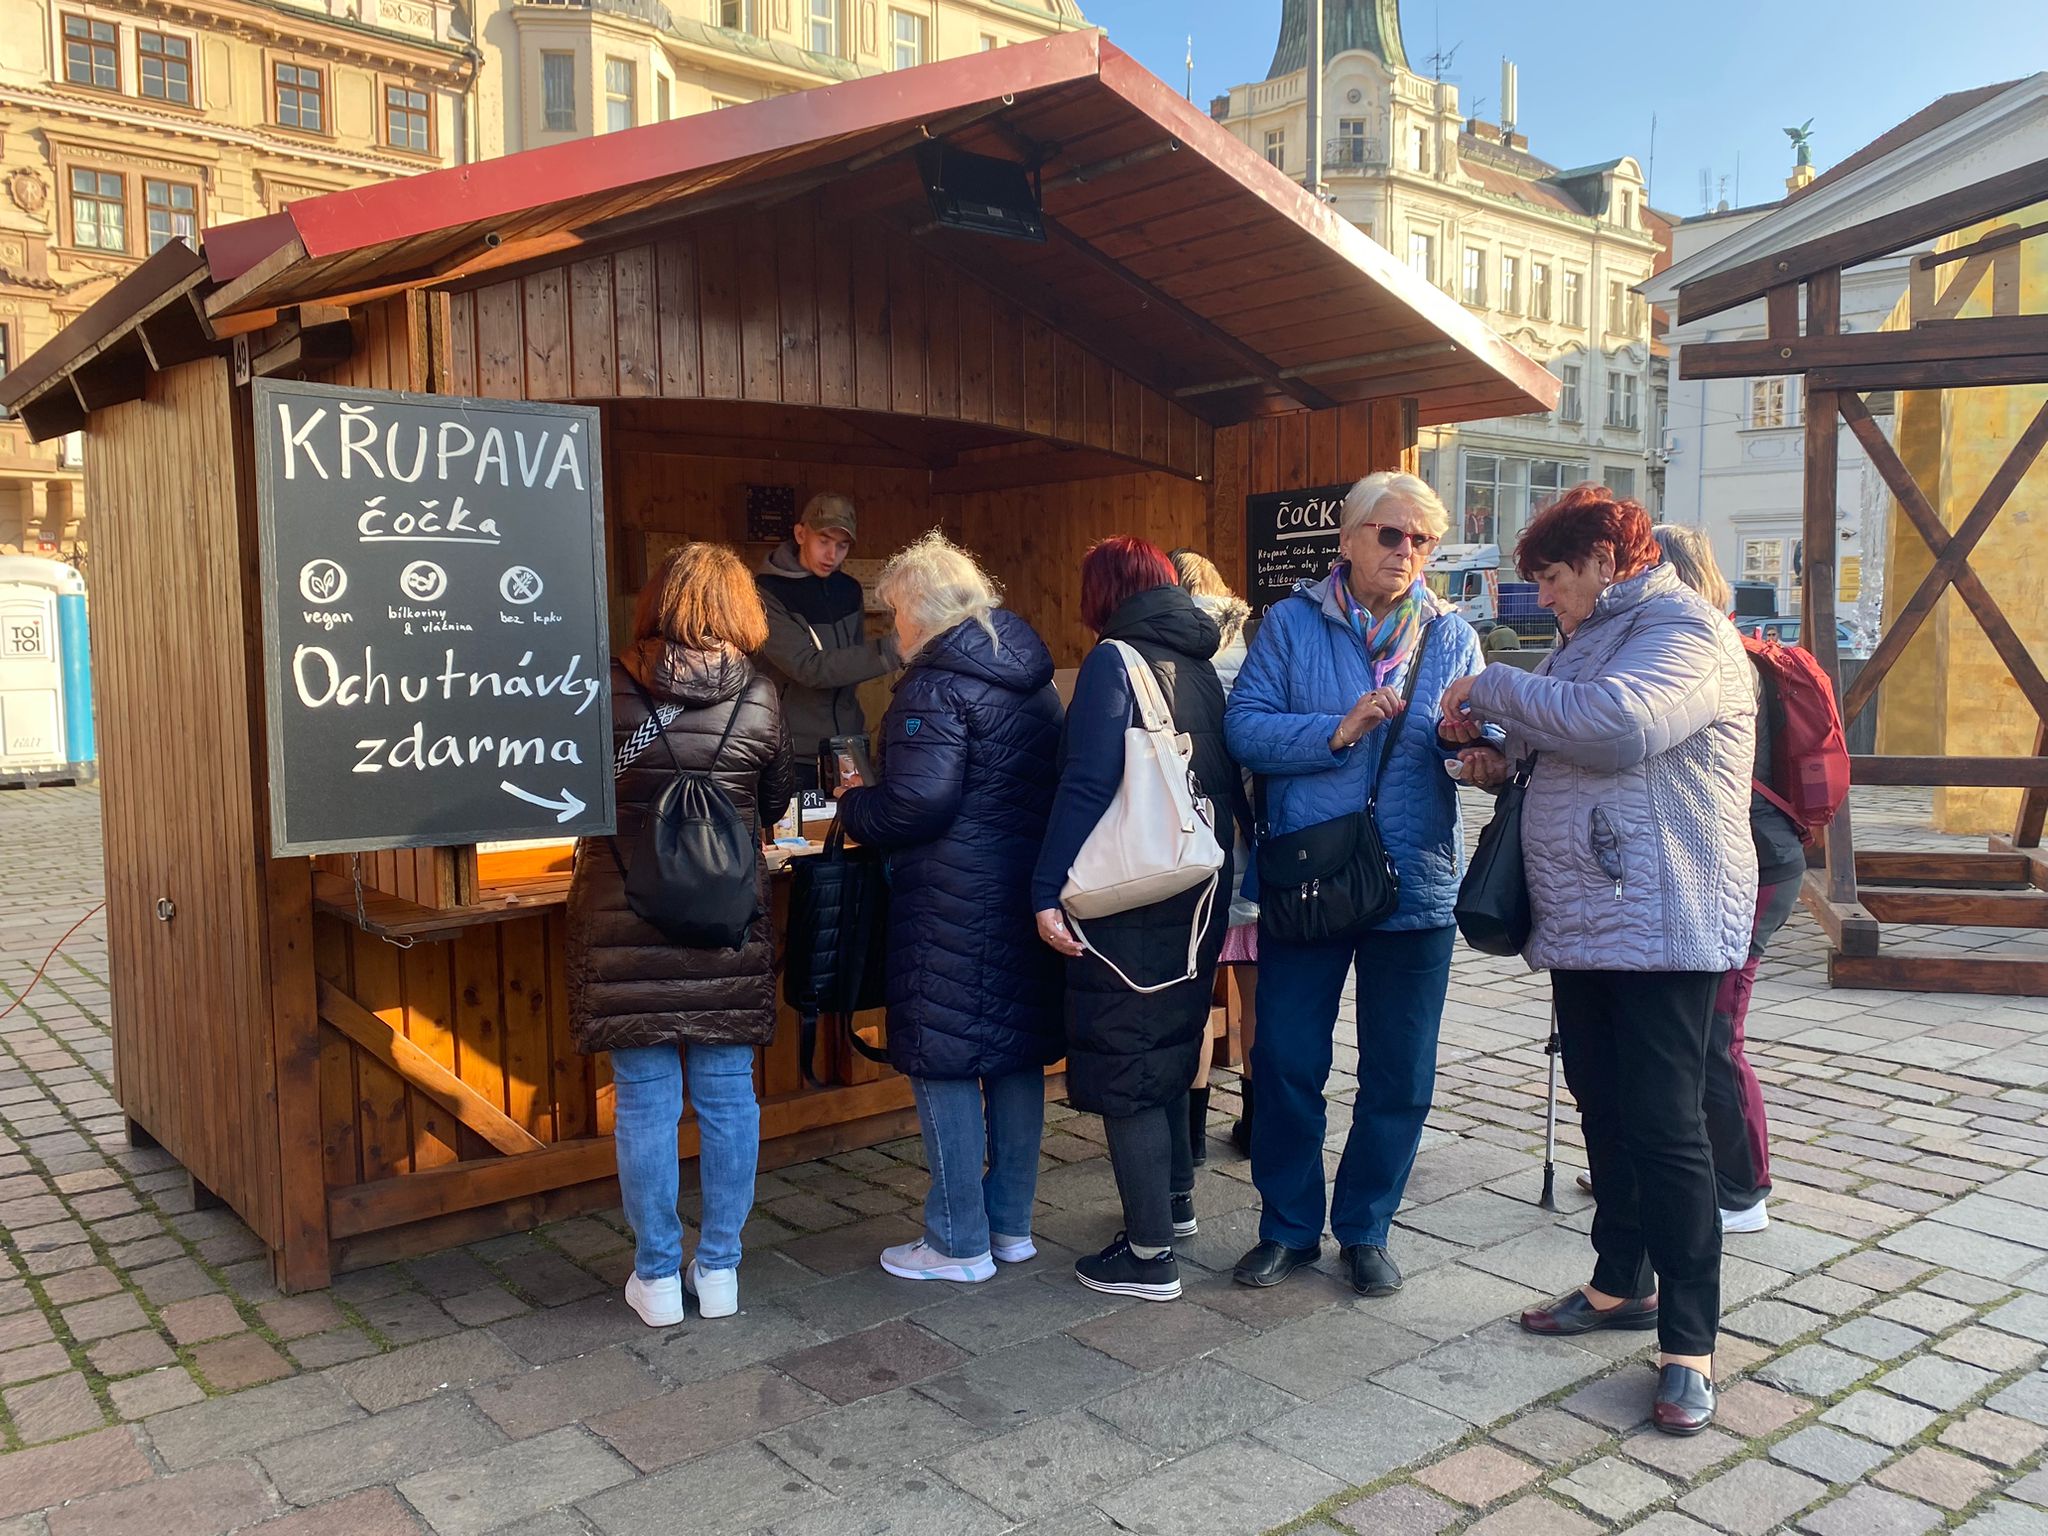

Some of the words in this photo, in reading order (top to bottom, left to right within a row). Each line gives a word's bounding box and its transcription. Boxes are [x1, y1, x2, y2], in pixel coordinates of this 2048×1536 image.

[236, 341, 247, 378] 49
[278, 402, 585, 491] KŘUPAVÁ
[1276, 498, 1344, 529] ČOČK
[303, 611, 354, 631] vegan
[388, 605, 447, 621] bílkoviny
[500, 611, 525, 624] bez
[533, 611, 562, 625] lepku
[11, 623, 39, 639] TOI
[404, 622, 413, 635] &
[12, 639, 40, 652] TOI
[292, 644, 600, 715] Ochutnávky
[351, 721, 584, 773] zdarma
